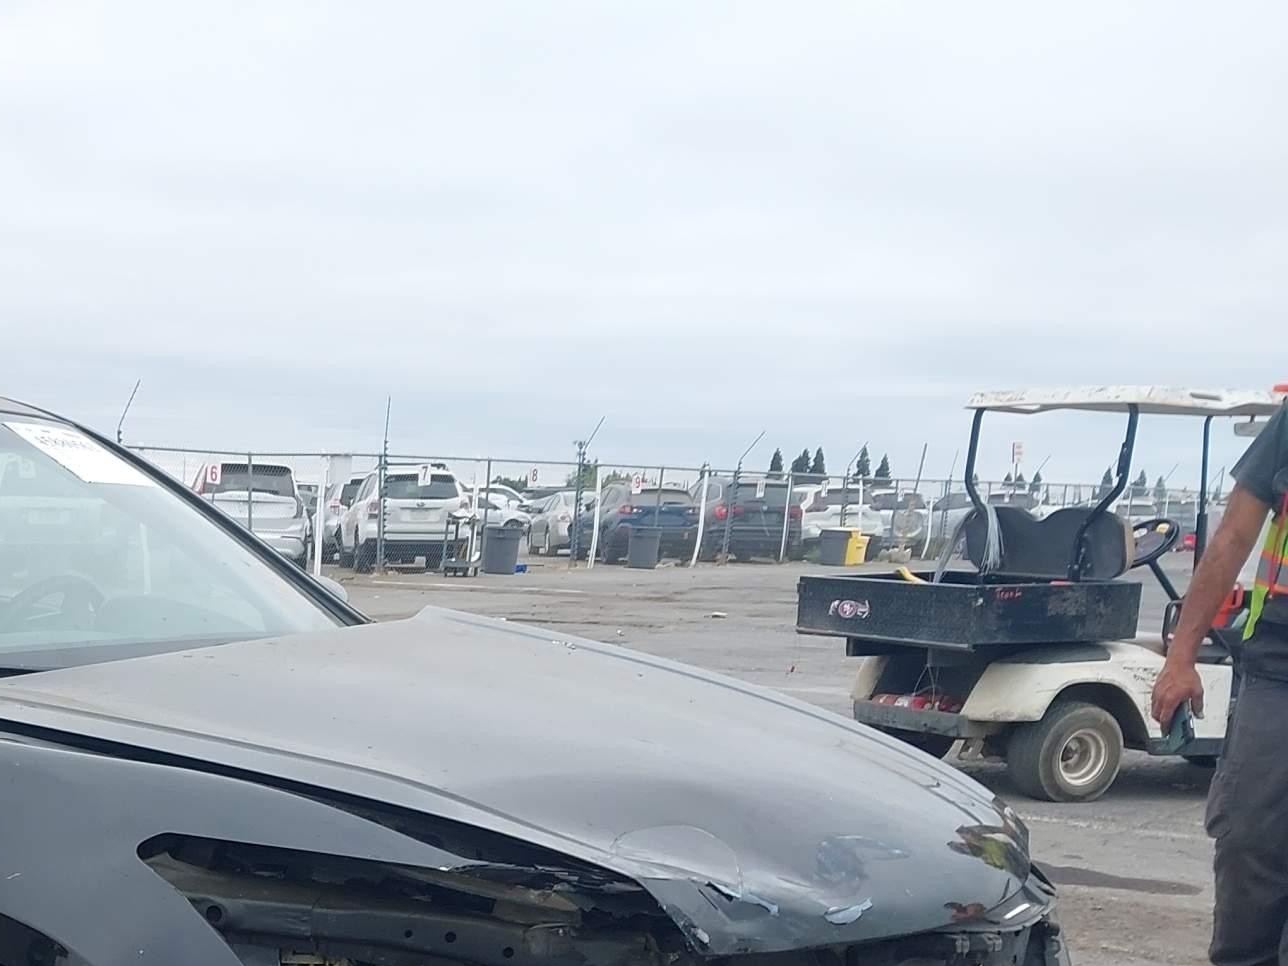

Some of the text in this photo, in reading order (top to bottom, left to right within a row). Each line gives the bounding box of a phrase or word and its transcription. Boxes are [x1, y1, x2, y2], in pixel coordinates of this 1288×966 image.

[210, 465, 218, 482] 6
[422, 465, 429, 481] 7
[532, 468, 538, 482] 8
[635, 476, 641, 489] 9
